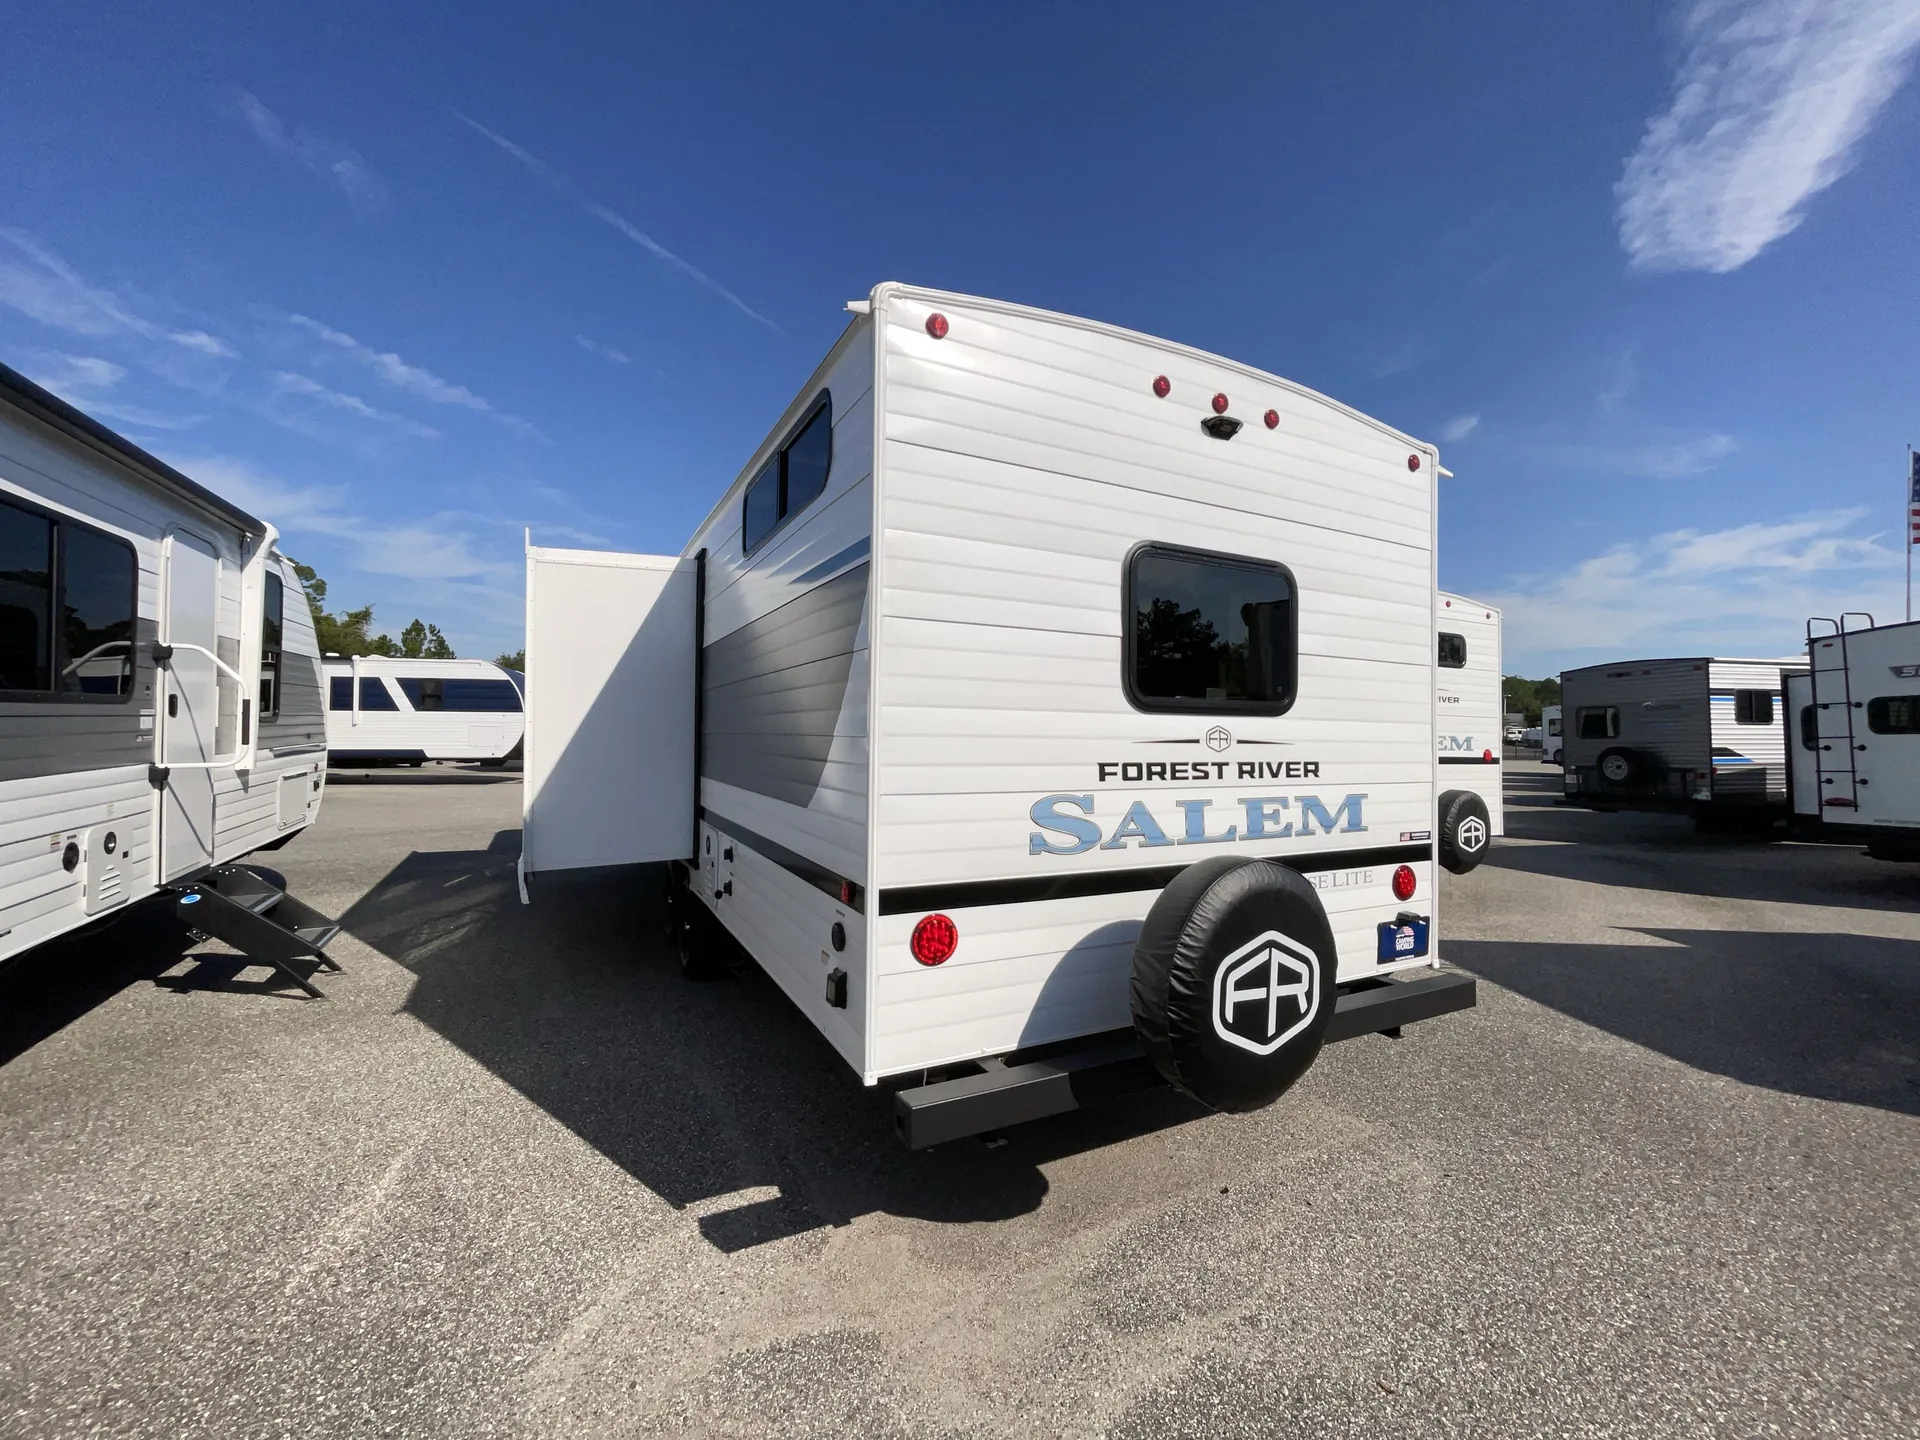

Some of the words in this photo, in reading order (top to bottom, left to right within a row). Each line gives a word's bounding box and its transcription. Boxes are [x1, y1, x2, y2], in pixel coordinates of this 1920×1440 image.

[1097, 762, 1229, 782] FOREST
[1237, 761, 1320, 779] RIVER
[1029, 793, 1369, 855] SALEM
[1331, 869, 1374, 887] LITE
